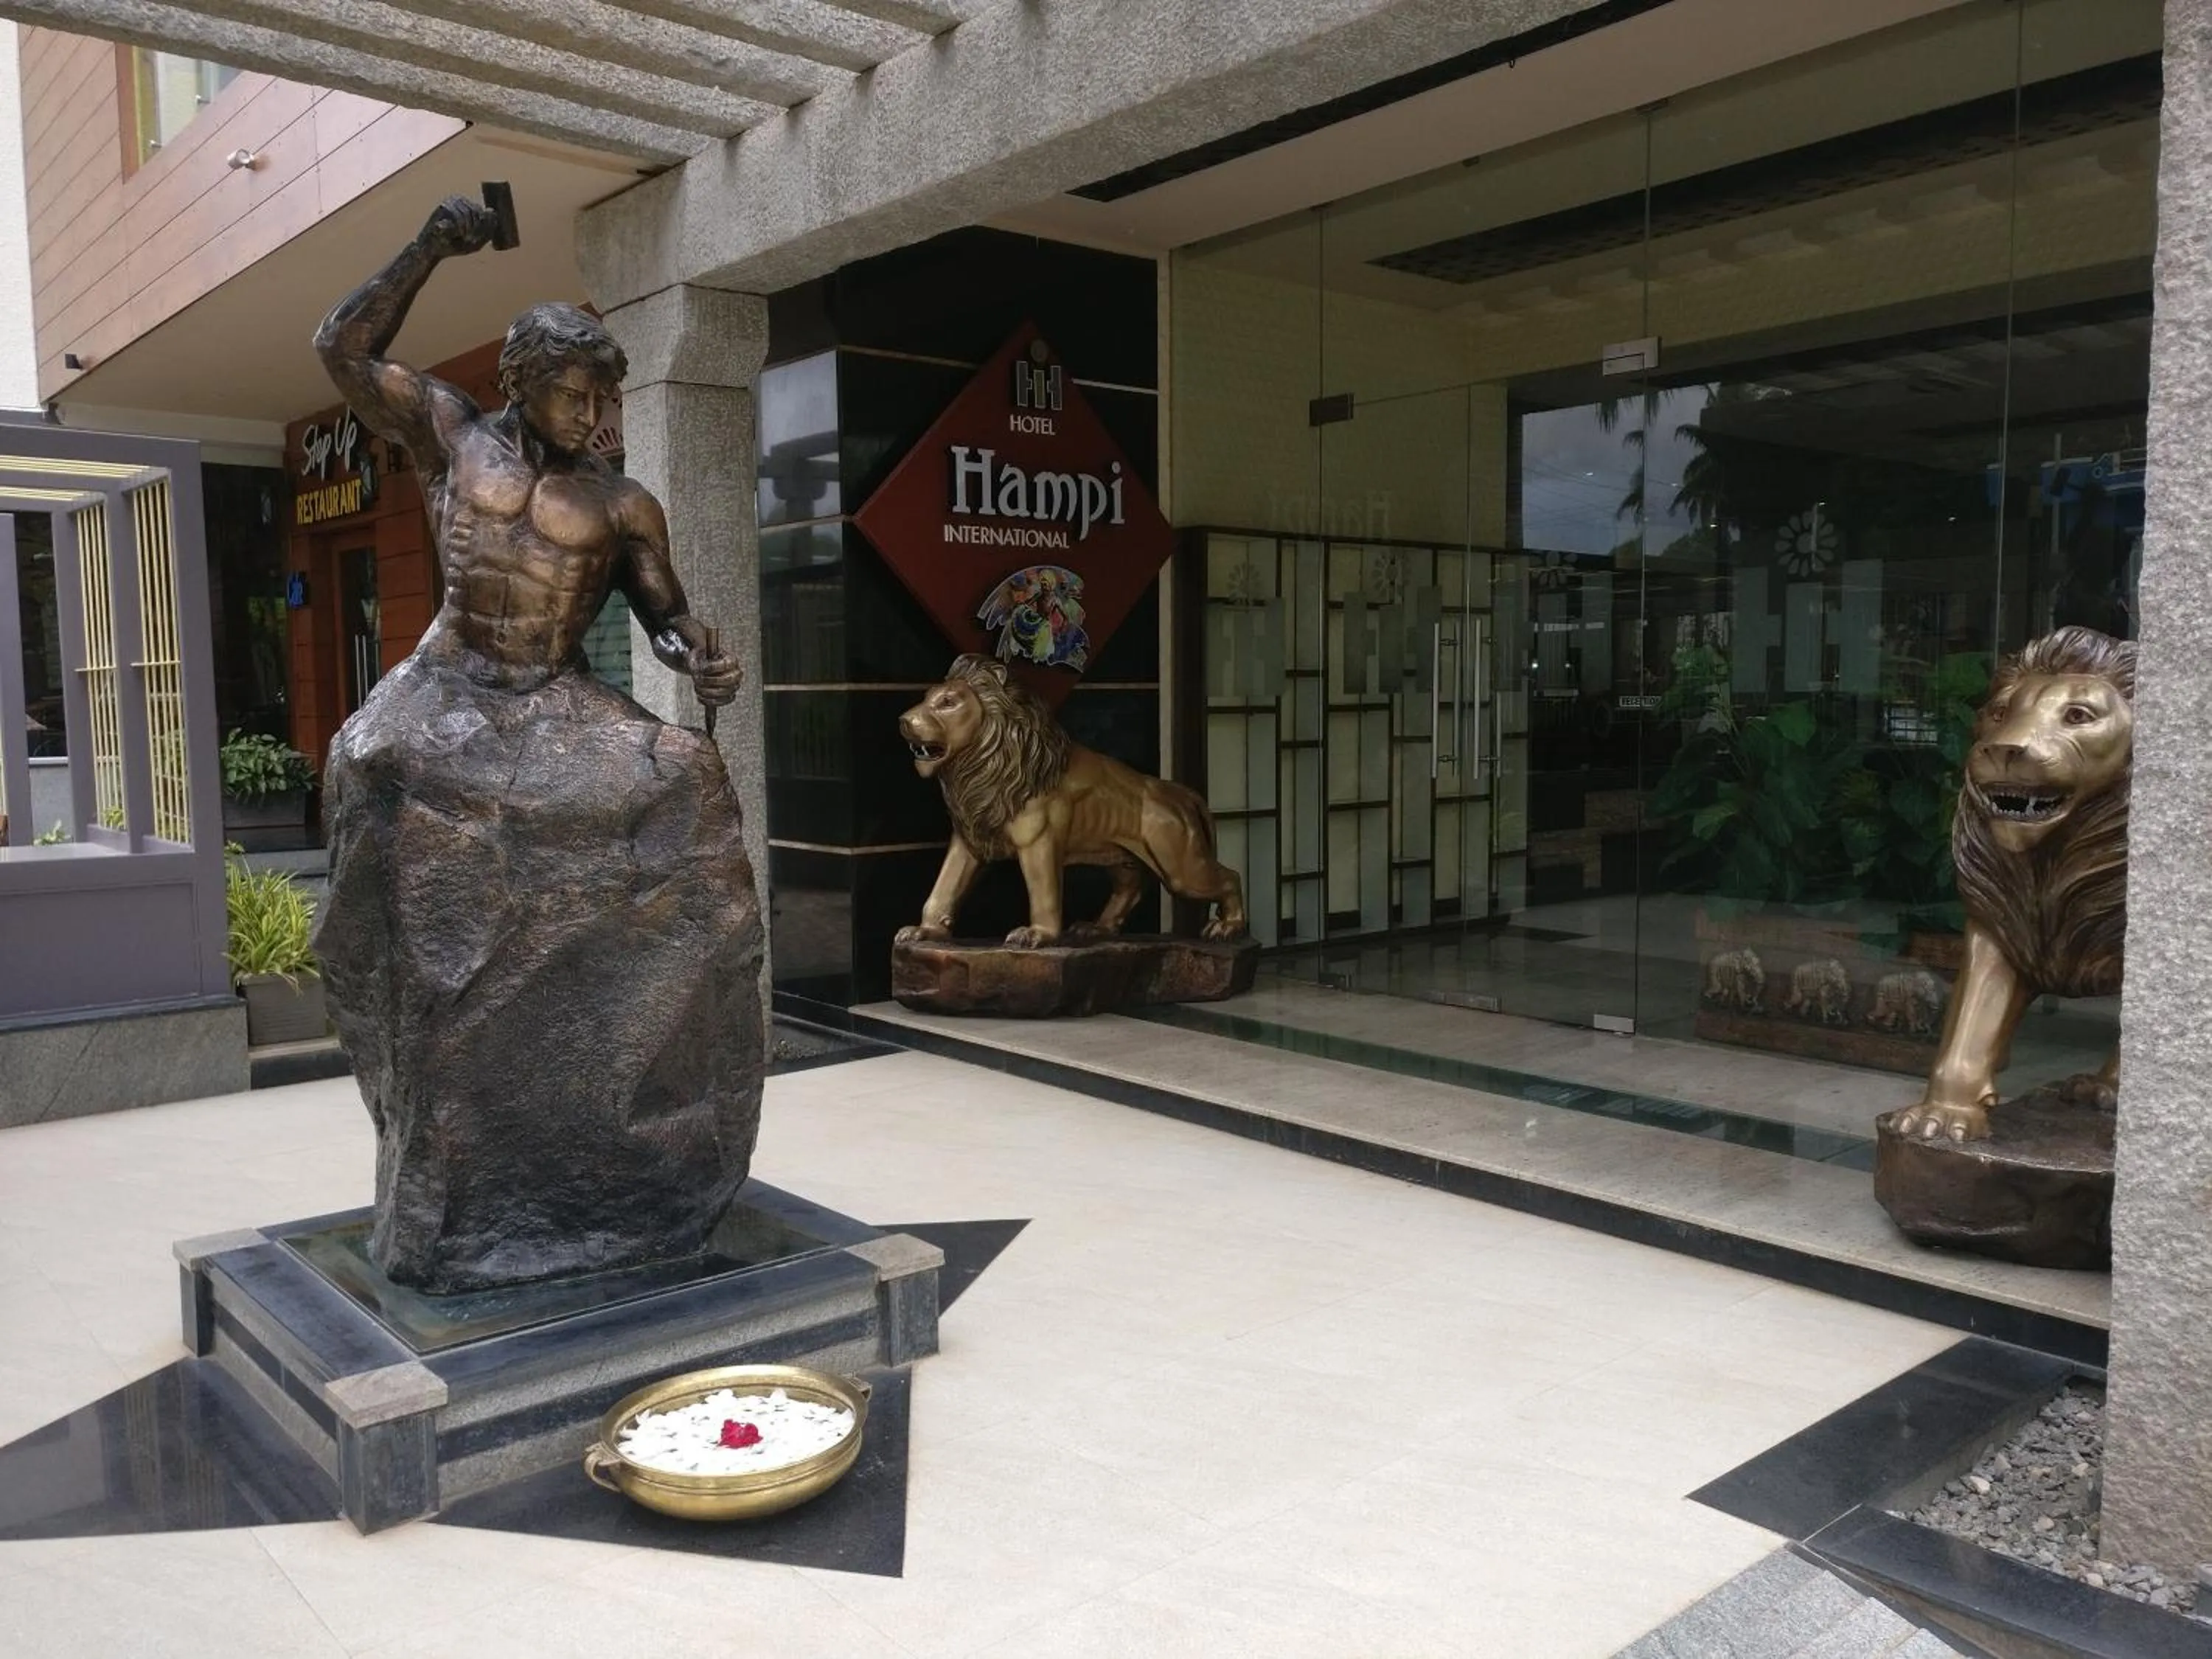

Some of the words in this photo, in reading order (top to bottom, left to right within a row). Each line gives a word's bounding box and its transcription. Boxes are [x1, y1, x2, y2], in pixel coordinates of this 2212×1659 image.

[334, 404, 358, 473] Up
[1009, 414, 1056, 436] HOTEL
[296, 478, 362, 525] RESTAURANT
[950, 445, 1125, 541] Hampi
[943, 524, 1070, 549] INTERNATIONAL
